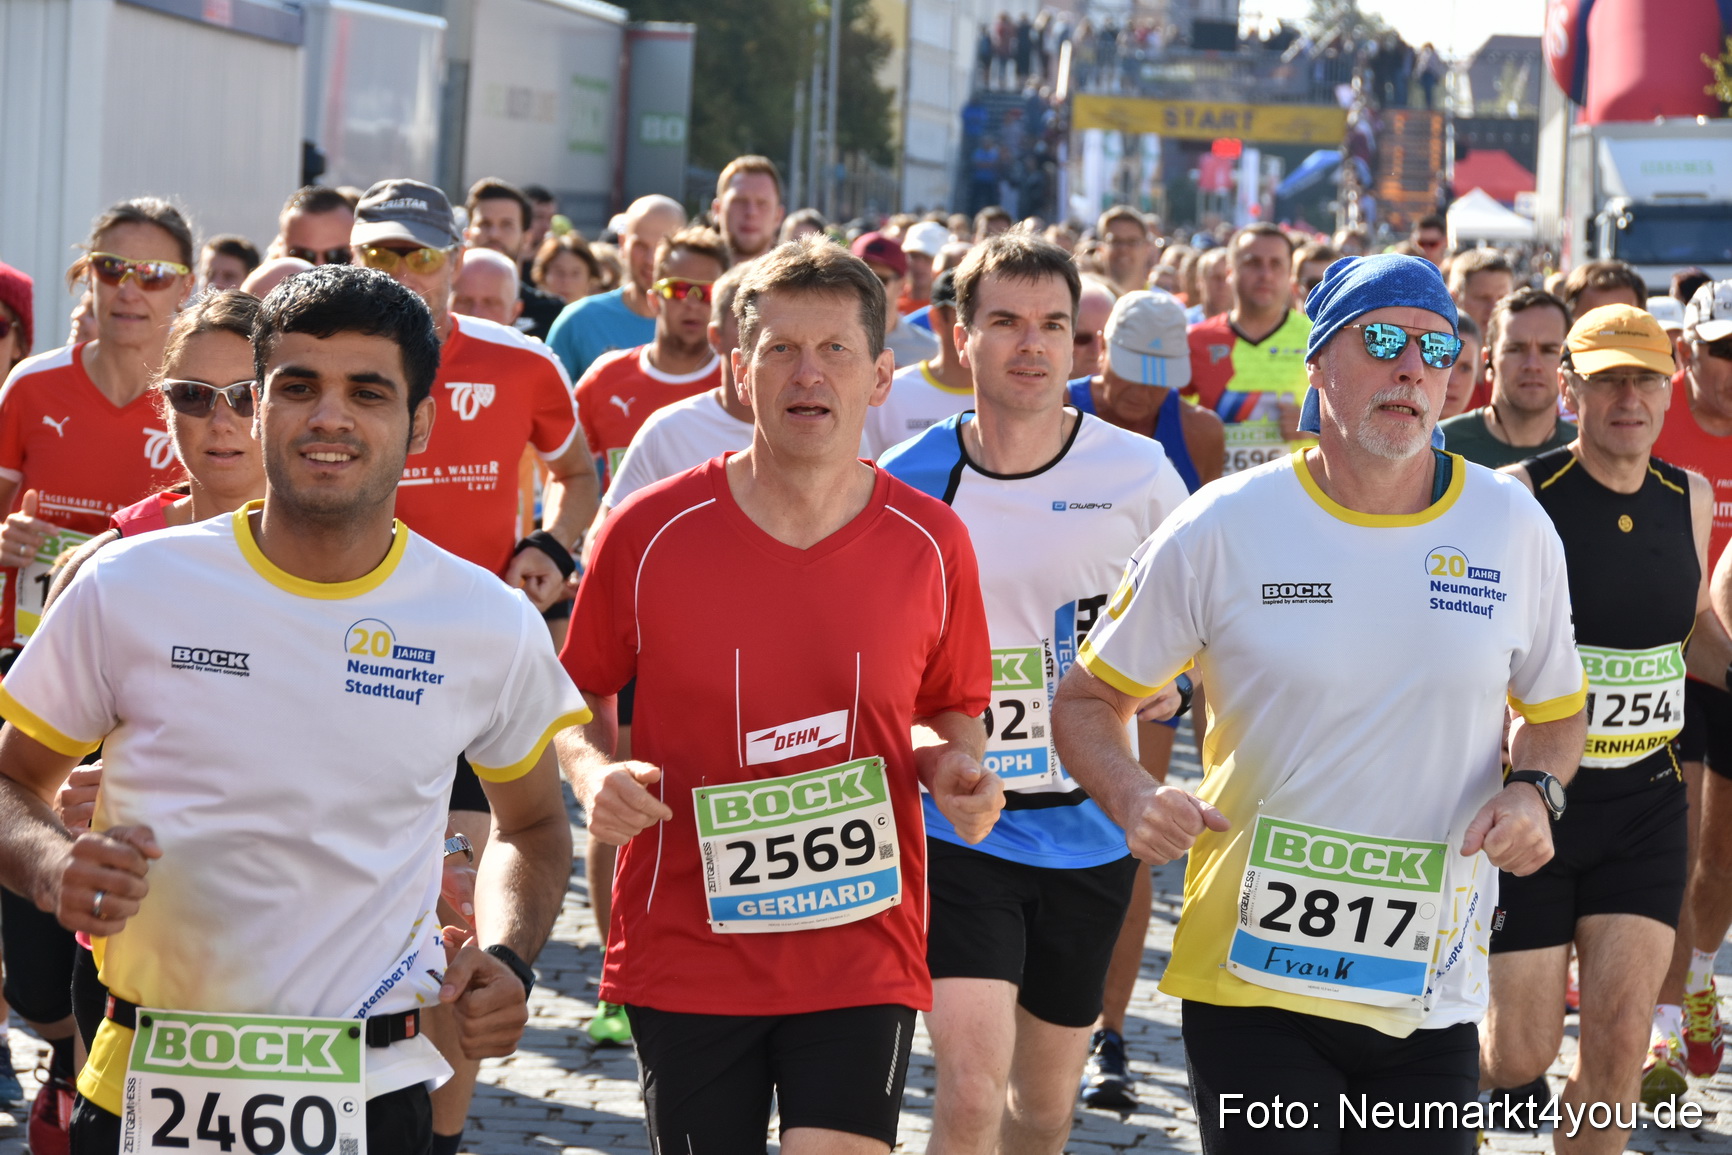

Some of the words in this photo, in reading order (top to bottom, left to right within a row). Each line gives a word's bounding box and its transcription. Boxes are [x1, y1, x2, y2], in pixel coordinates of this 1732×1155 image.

[1163, 107, 1257, 129] START
[448, 460, 499, 475] WALTER
[1431, 554, 1465, 577] 20
[1470, 568, 1499, 581] JAHRE
[1262, 583, 1333, 599] BOCK
[1430, 581, 1507, 602] Neumarkter
[1430, 598, 1494, 619] Stadtlauf
[172, 646, 250, 670] BOCK
[349, 628, 391, 657] 20
[395, 647, 432, 662] JAHRE
[347, 659, 445, 684] Neumarkter
[345, 679, 424, 705] Stadtlauf
[774, 726, 820, 751] DEHN
[709, 765, 875, 830] BOCK
[726, 818, 876, 886] 2569
[1264, 826, 1433, 886] BOCK
[737, 881, 876, 916] GERHARD
[1259, 881, 1418, 948] 2817
[144, 1020, 343, 1075] BOCK
[151, 1087, 336, 1155] 2460
